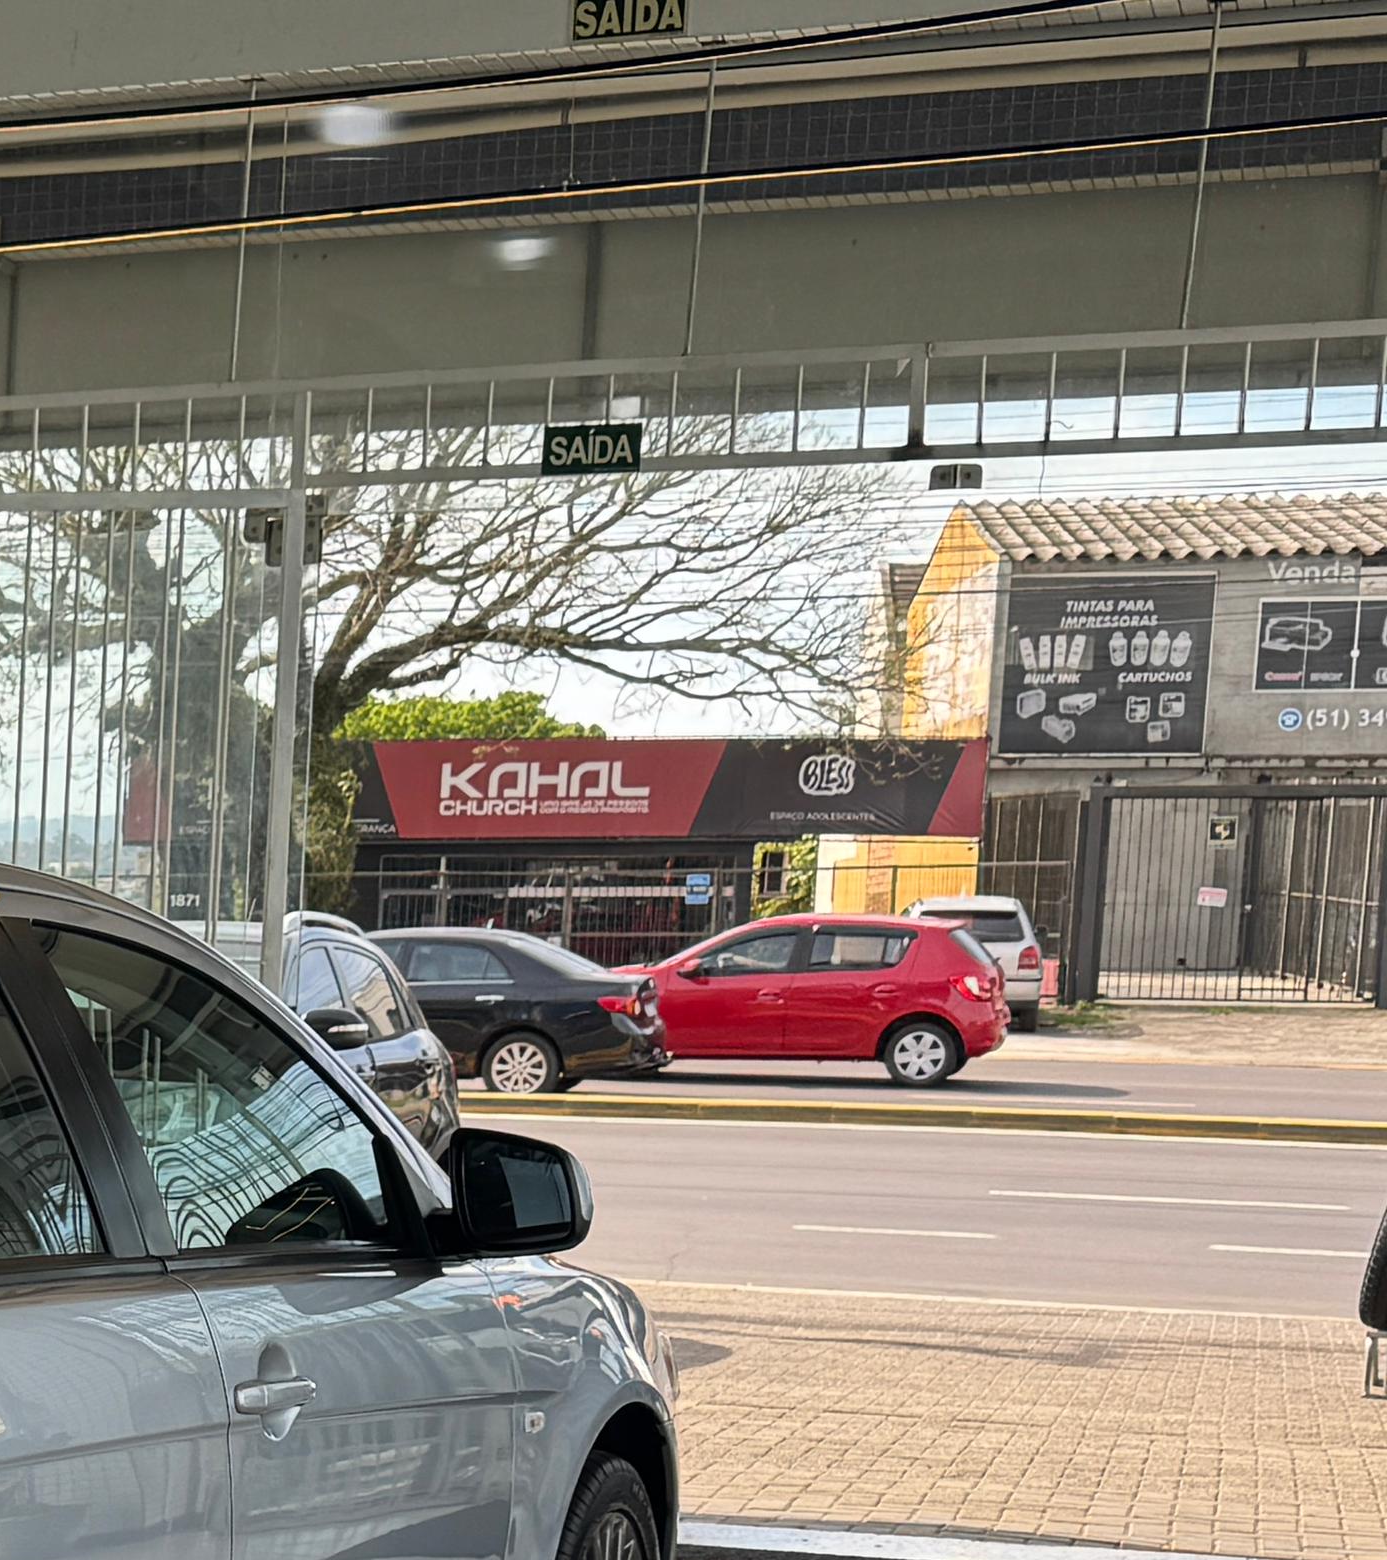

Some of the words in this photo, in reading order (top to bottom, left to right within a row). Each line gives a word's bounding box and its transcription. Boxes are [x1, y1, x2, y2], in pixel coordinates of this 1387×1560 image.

[549, 427, 634, 467] SAÍDA
[1267, 560, 1357, 585] Venda
[1065, 599, 1115, 613] TINTAS
[1116, 598, 1156, 612] PARA
[1059, 613, 1160, 629] IMPRESSORAS
[1024, 673, 1056, 685] BULK
[1057, 672, 1083, 684] INK
[1117, 671, 1193, 684] CARTUCHOS
[1306, 707, 1351, 731] (51)
[439, 760, 651, 799] KAHAL
[439, 800, 538, 816] CHURCH
[170, 893, 200, 907] 1871
